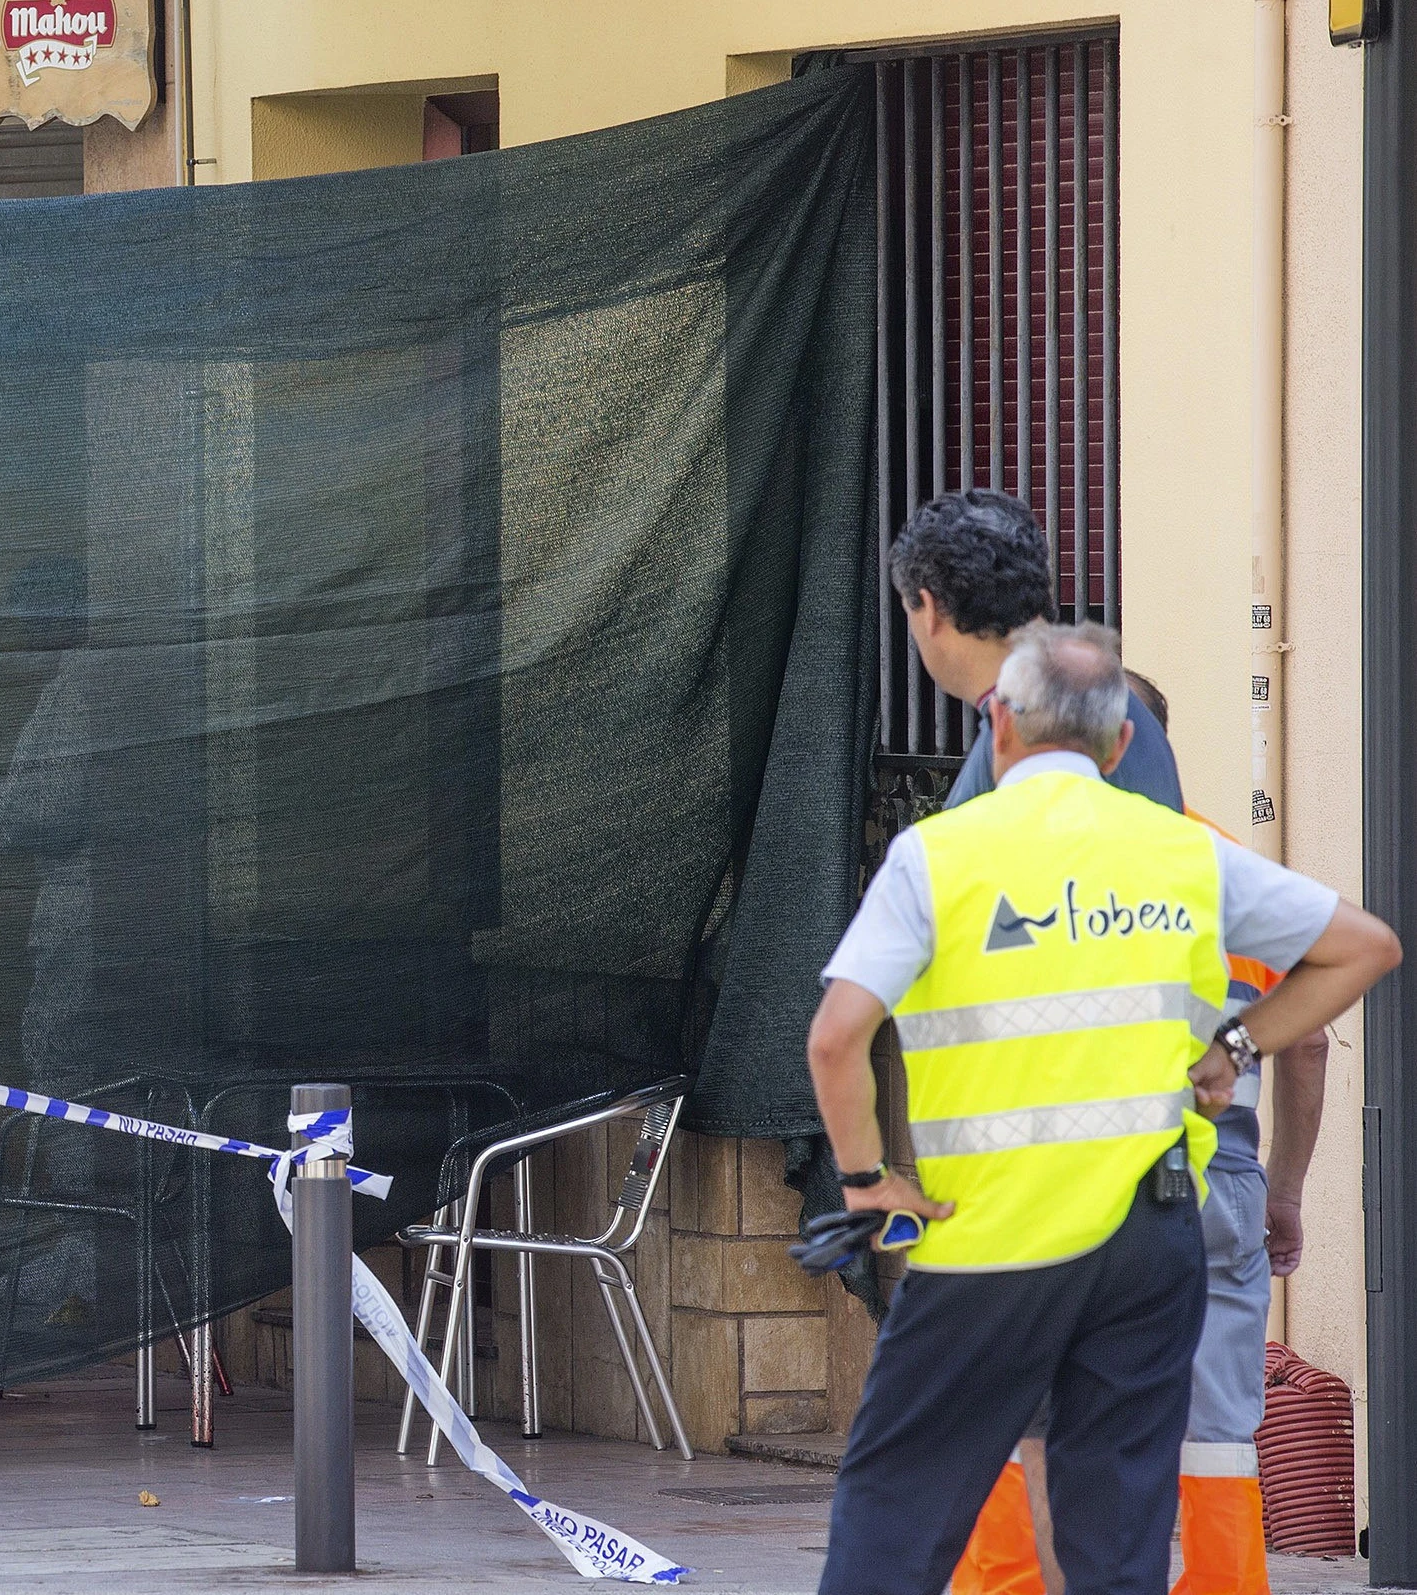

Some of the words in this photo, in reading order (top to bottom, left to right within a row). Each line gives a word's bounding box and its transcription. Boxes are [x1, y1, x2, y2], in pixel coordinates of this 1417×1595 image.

[10, 5, 108, 37] Mahou
[1067, 880, 1196, 941] fobesa
[544, 1508, 578, 1536] NO
[581, 1524, 646, 1573] PASAR
